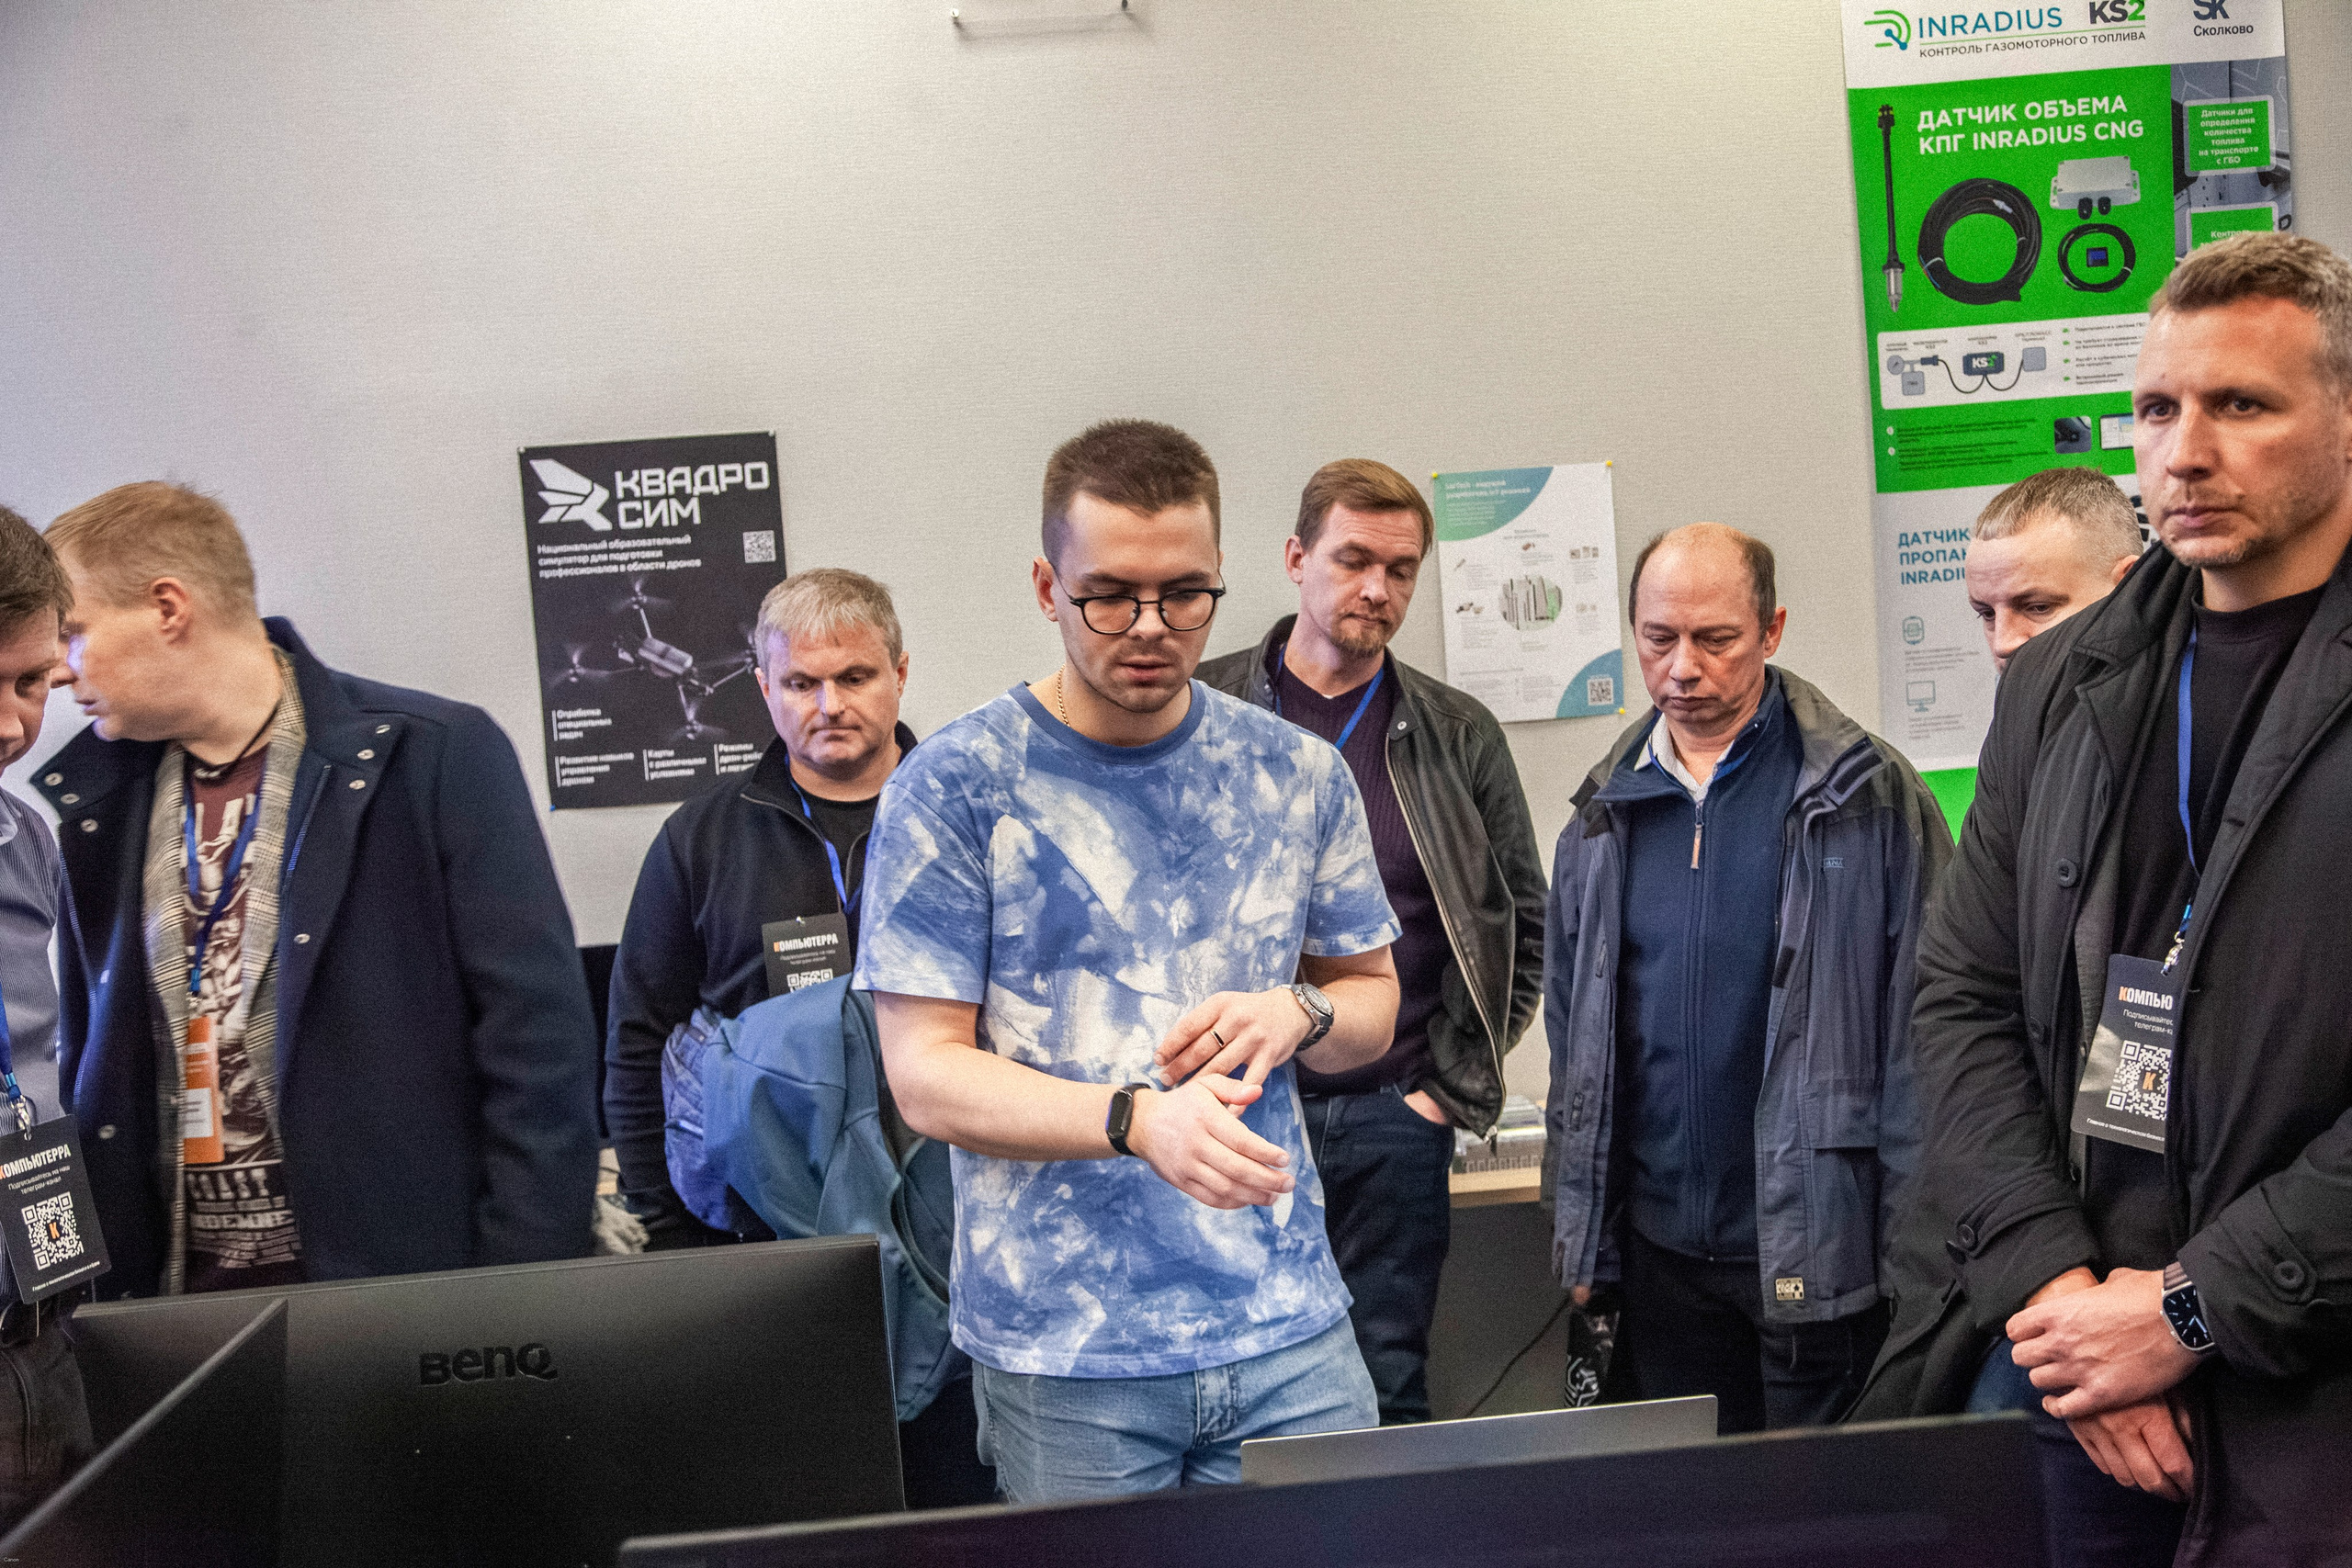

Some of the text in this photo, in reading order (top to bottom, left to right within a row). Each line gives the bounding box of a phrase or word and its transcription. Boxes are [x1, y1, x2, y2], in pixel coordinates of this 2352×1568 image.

[1918, 0, 2145, 39] INRADIUS KS2
[2193, 25, 2254, 37] Сколково
[1920, 31, 2146, 58] КОНТРОЛЬ ГАЗОМОТОРНОГО ТОПЛИВА
[1917, 95, 2128, 132] ДАТЧИК ОБЪЕМА
[2200, 107, 2254, 118] Датчики для
[2200, 118, 2256, 128] определения
[1919, 119, 2143, 155] КПГ INRADIUS CNG
[2204, 128, 2252, 136] количества
[2211, 146, 2259, 155] транспорте
[2222, 155, 2241, 164] ГБО
[615, 461, 770, 499] КВАДРО
[617, 496, 702, 530] СИМ
[537, 534, 692, 555] Национальный образовательный
[1898, 527, 1970, 548] ДАТЧИК
[774, 933, 839, 953] КОМПЬЮТЕРРА
[2118, 986, 2173, 1010] КОМПЬЮ
[0, 1144, 72, 1180] КОМПЬЮТЕРРА
[419, 1342, 559, 1387] BenQ
